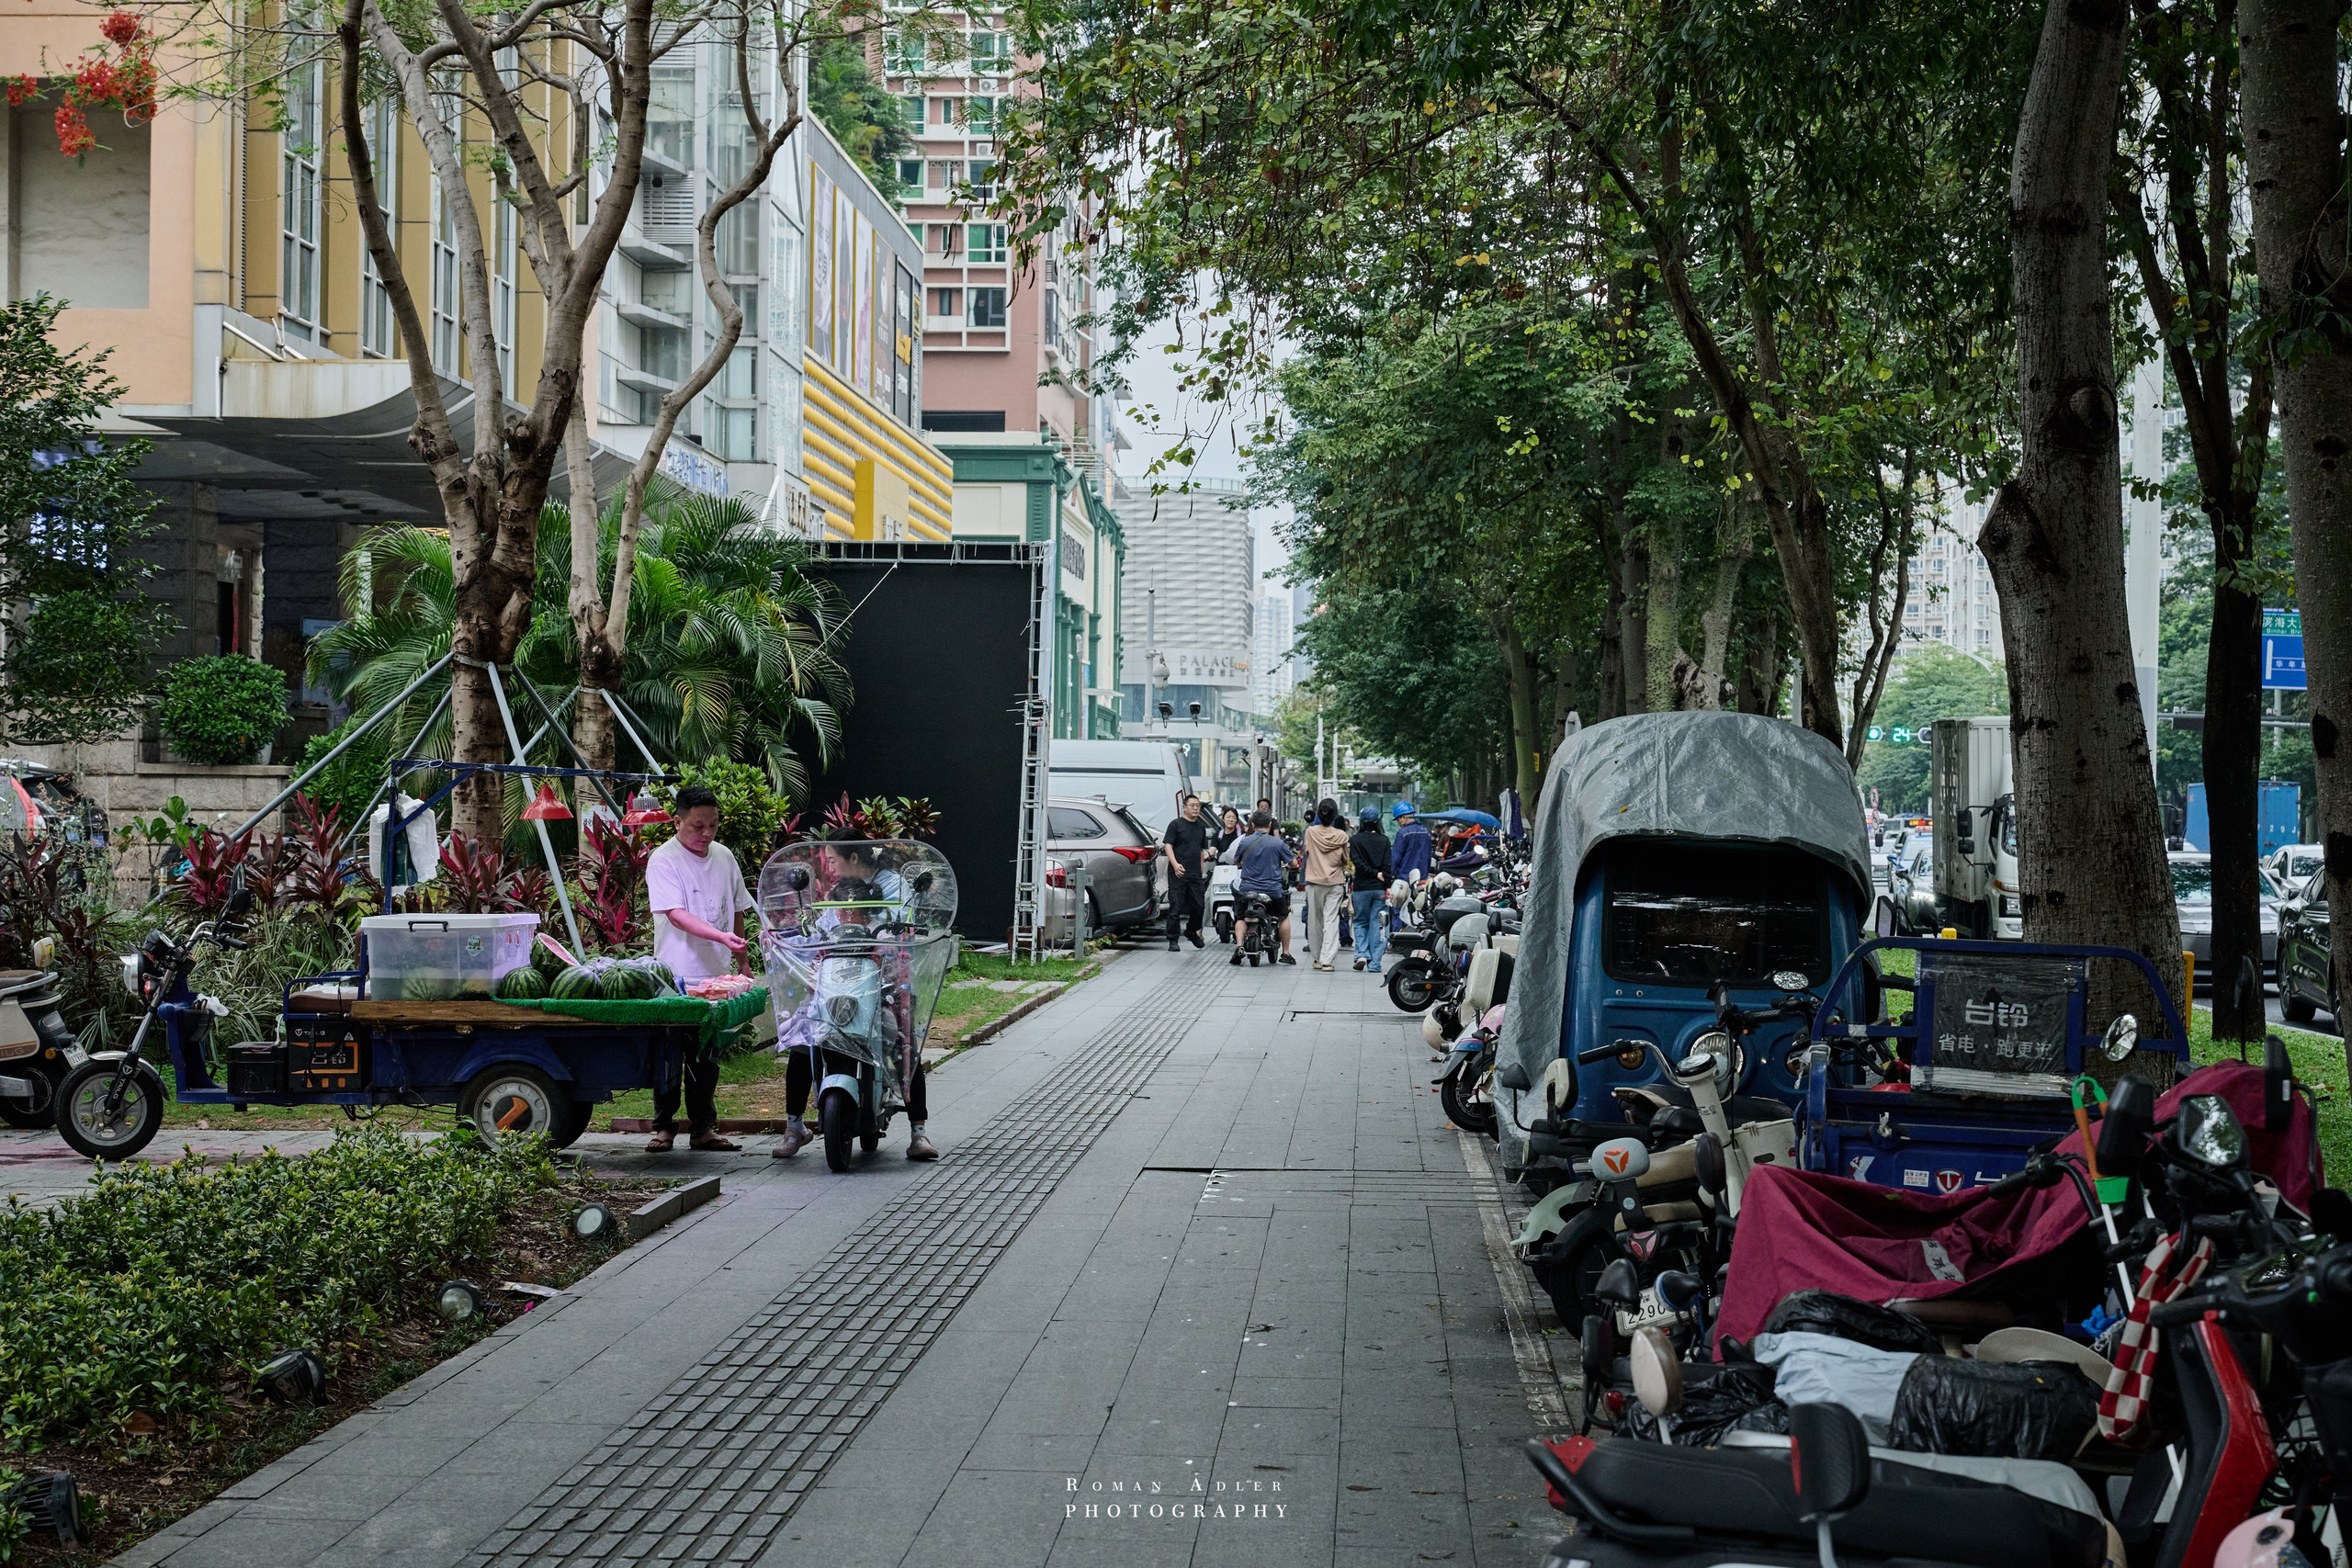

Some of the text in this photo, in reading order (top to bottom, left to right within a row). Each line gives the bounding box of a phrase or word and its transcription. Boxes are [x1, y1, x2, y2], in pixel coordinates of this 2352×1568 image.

[2263, 616, 2301, 628] 滨海大
[1180, 655, 1235, 668] PALACE
[1893, 728, 1910, 742] 24
[2257, 823, 2296, 834] 29J
[1965, 998, 2029, 1028] 台铃
[0, 1047, 25, 1057] ILG
[113, 1077, 127, 1100] TAILG
